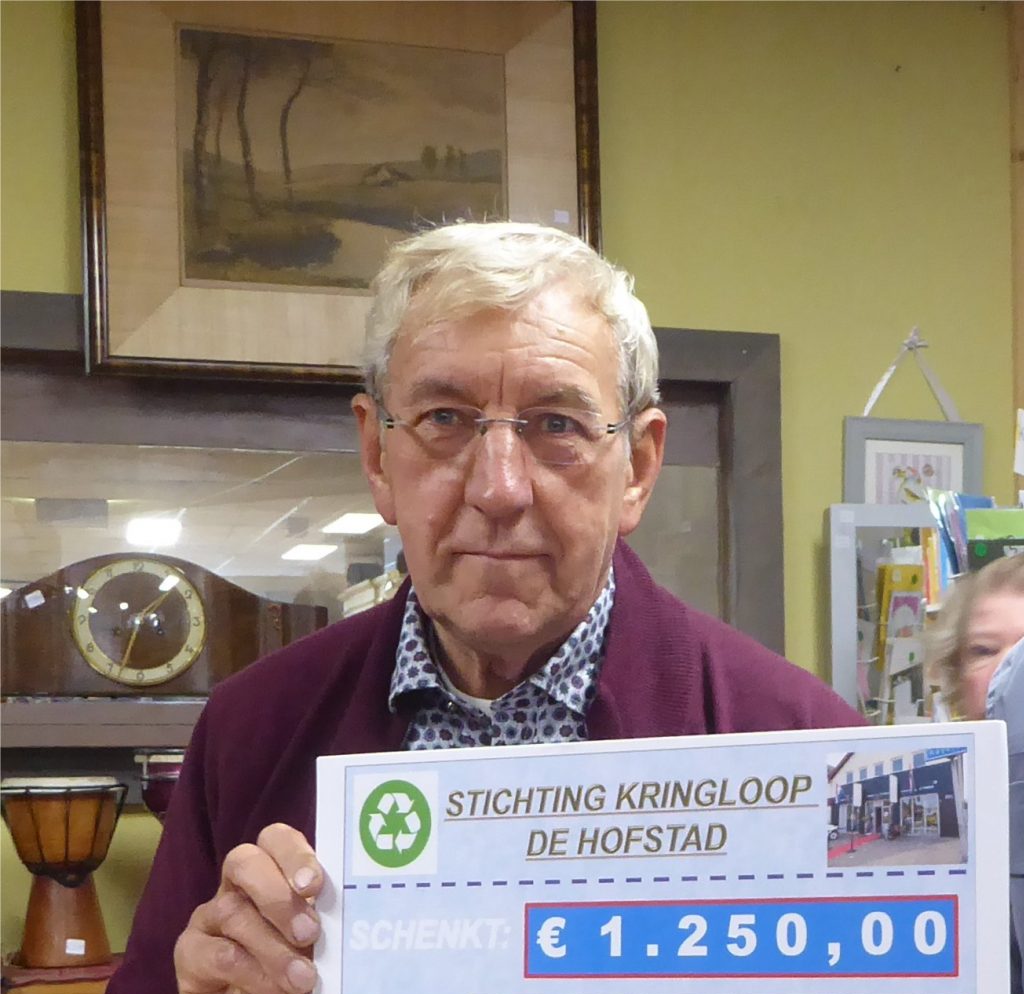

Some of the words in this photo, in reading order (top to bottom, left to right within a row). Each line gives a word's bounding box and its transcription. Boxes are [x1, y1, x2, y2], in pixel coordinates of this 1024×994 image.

[445, 783, 607, 818] STICHTING
[615, 774, 813, 811] KRINGLOOP
[526, 827, 570, 857] DE
[577, 822, 728, 855] HOFSTAD
[350, 918, 512, 950] SCHENKT:
[536, 916, 567, 958] €
